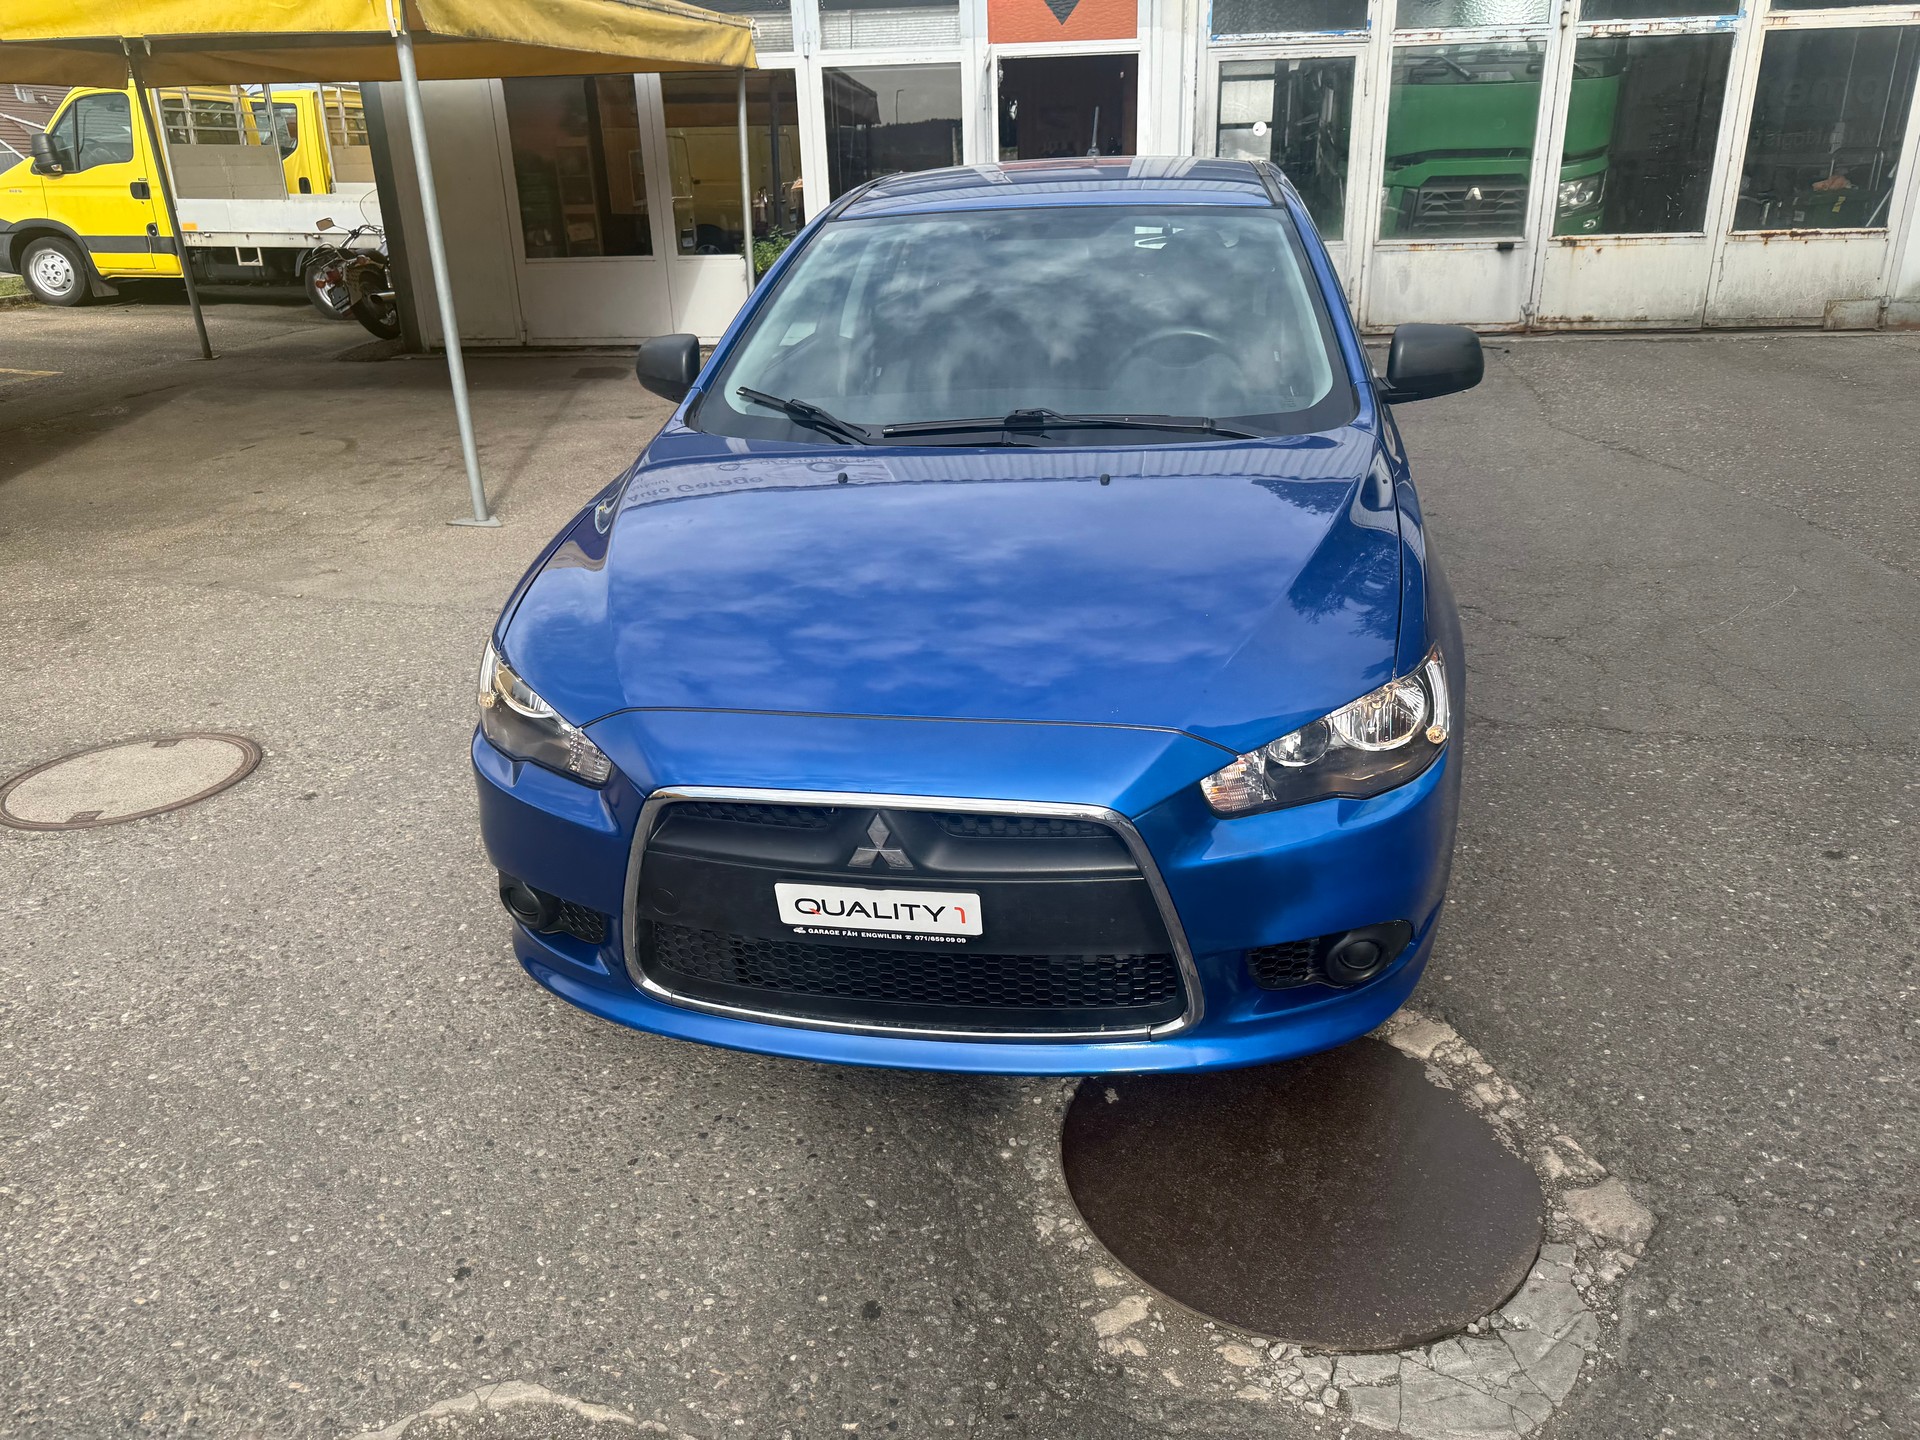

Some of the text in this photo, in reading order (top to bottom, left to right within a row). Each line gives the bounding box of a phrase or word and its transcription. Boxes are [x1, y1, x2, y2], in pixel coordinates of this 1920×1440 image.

[794, 897, 966, 924] QUALITY 1
[807, 928, 840, 936] GARAGE
[861, 932, 902, 940] ENGWILEN
